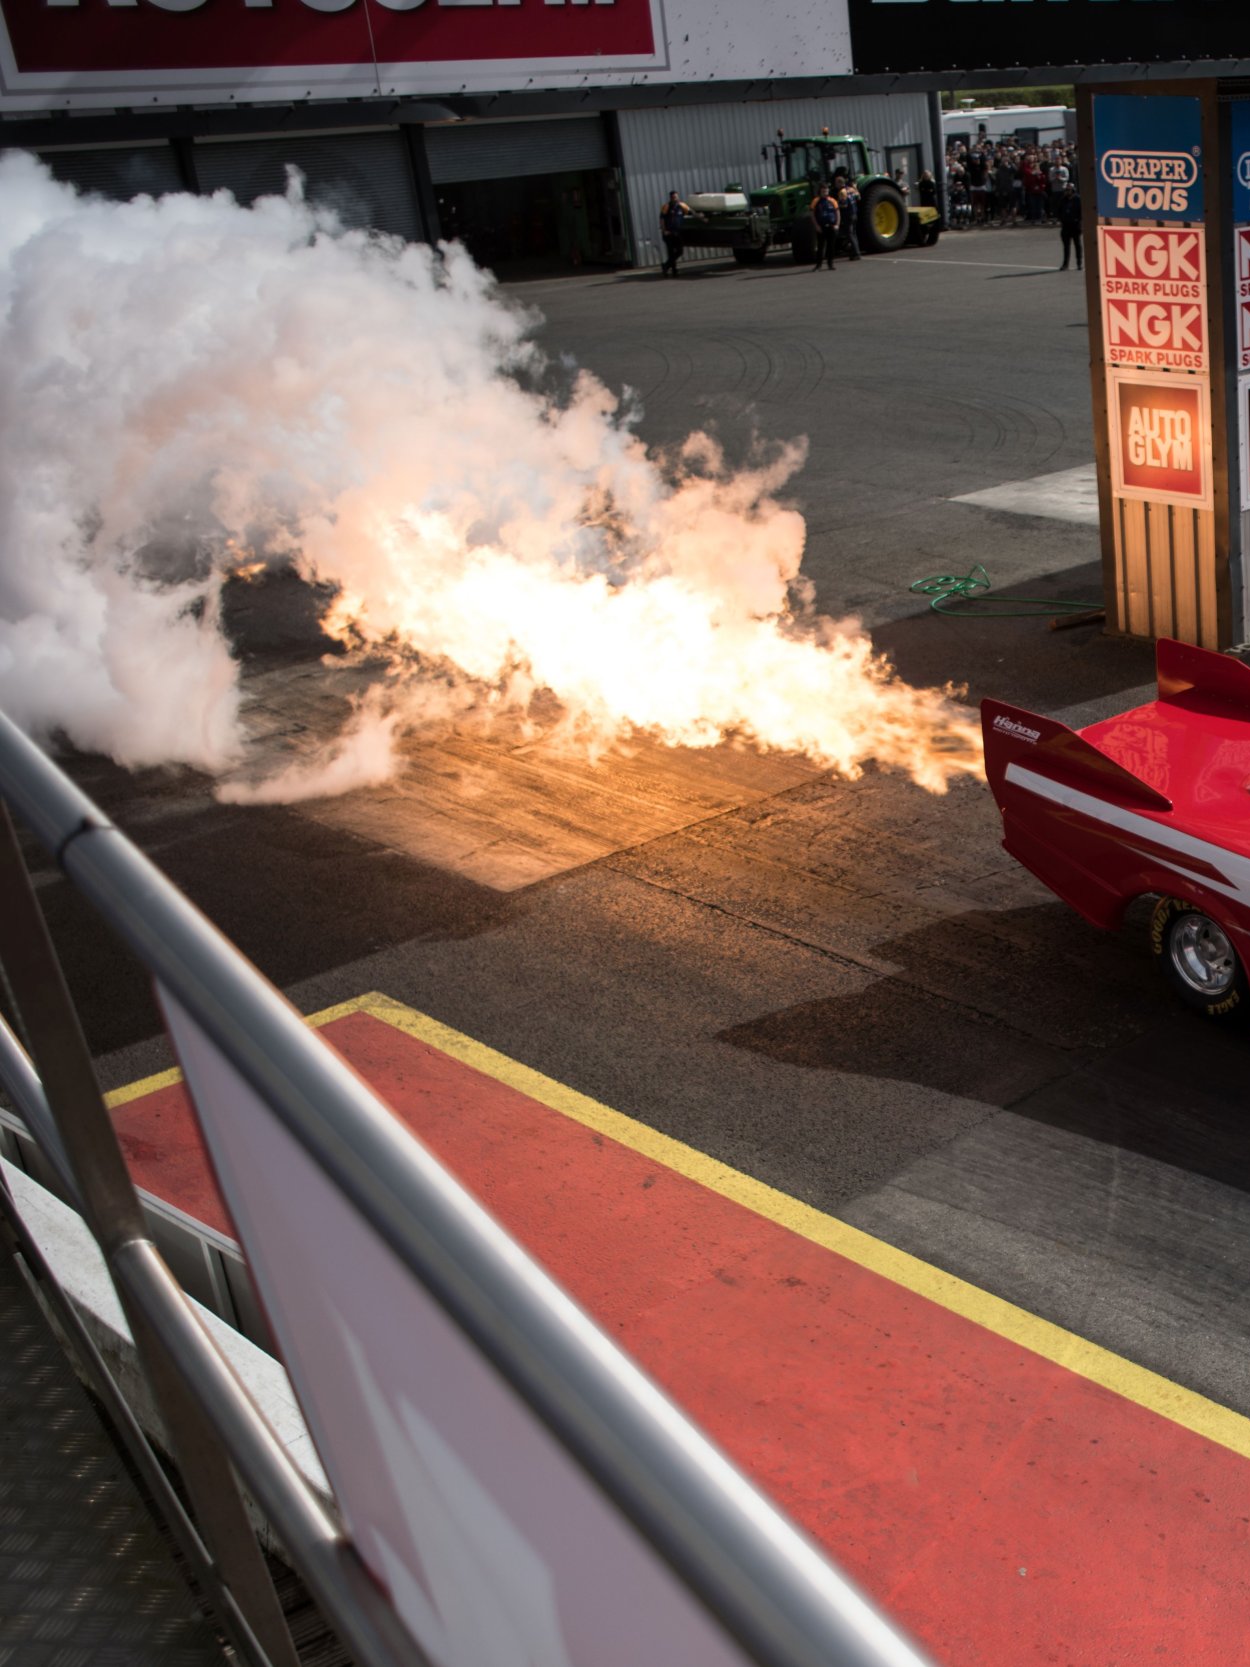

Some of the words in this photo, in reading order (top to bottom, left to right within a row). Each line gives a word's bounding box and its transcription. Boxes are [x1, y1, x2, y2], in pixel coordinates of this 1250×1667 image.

[1110, 157, 1188, 181] DRAPER
[1113, 179, 1188, 212] Tools
[1105, 232, 1200, 281] NGK
[1106, 280, 1150, 295] SPARK
[1153, 283, 1200, 298] PLUGS
[1108, 301, 1202, 351] NGK
[1110, 349, 1153, 365] SPARK
[1156, 352, 1203, 369] PLUGS
[1128, 406, 1192, 442] AUTO
[1128, 434, 1193, 471] GLYM
[1207, 990, 1240, 1016] EAGLE
